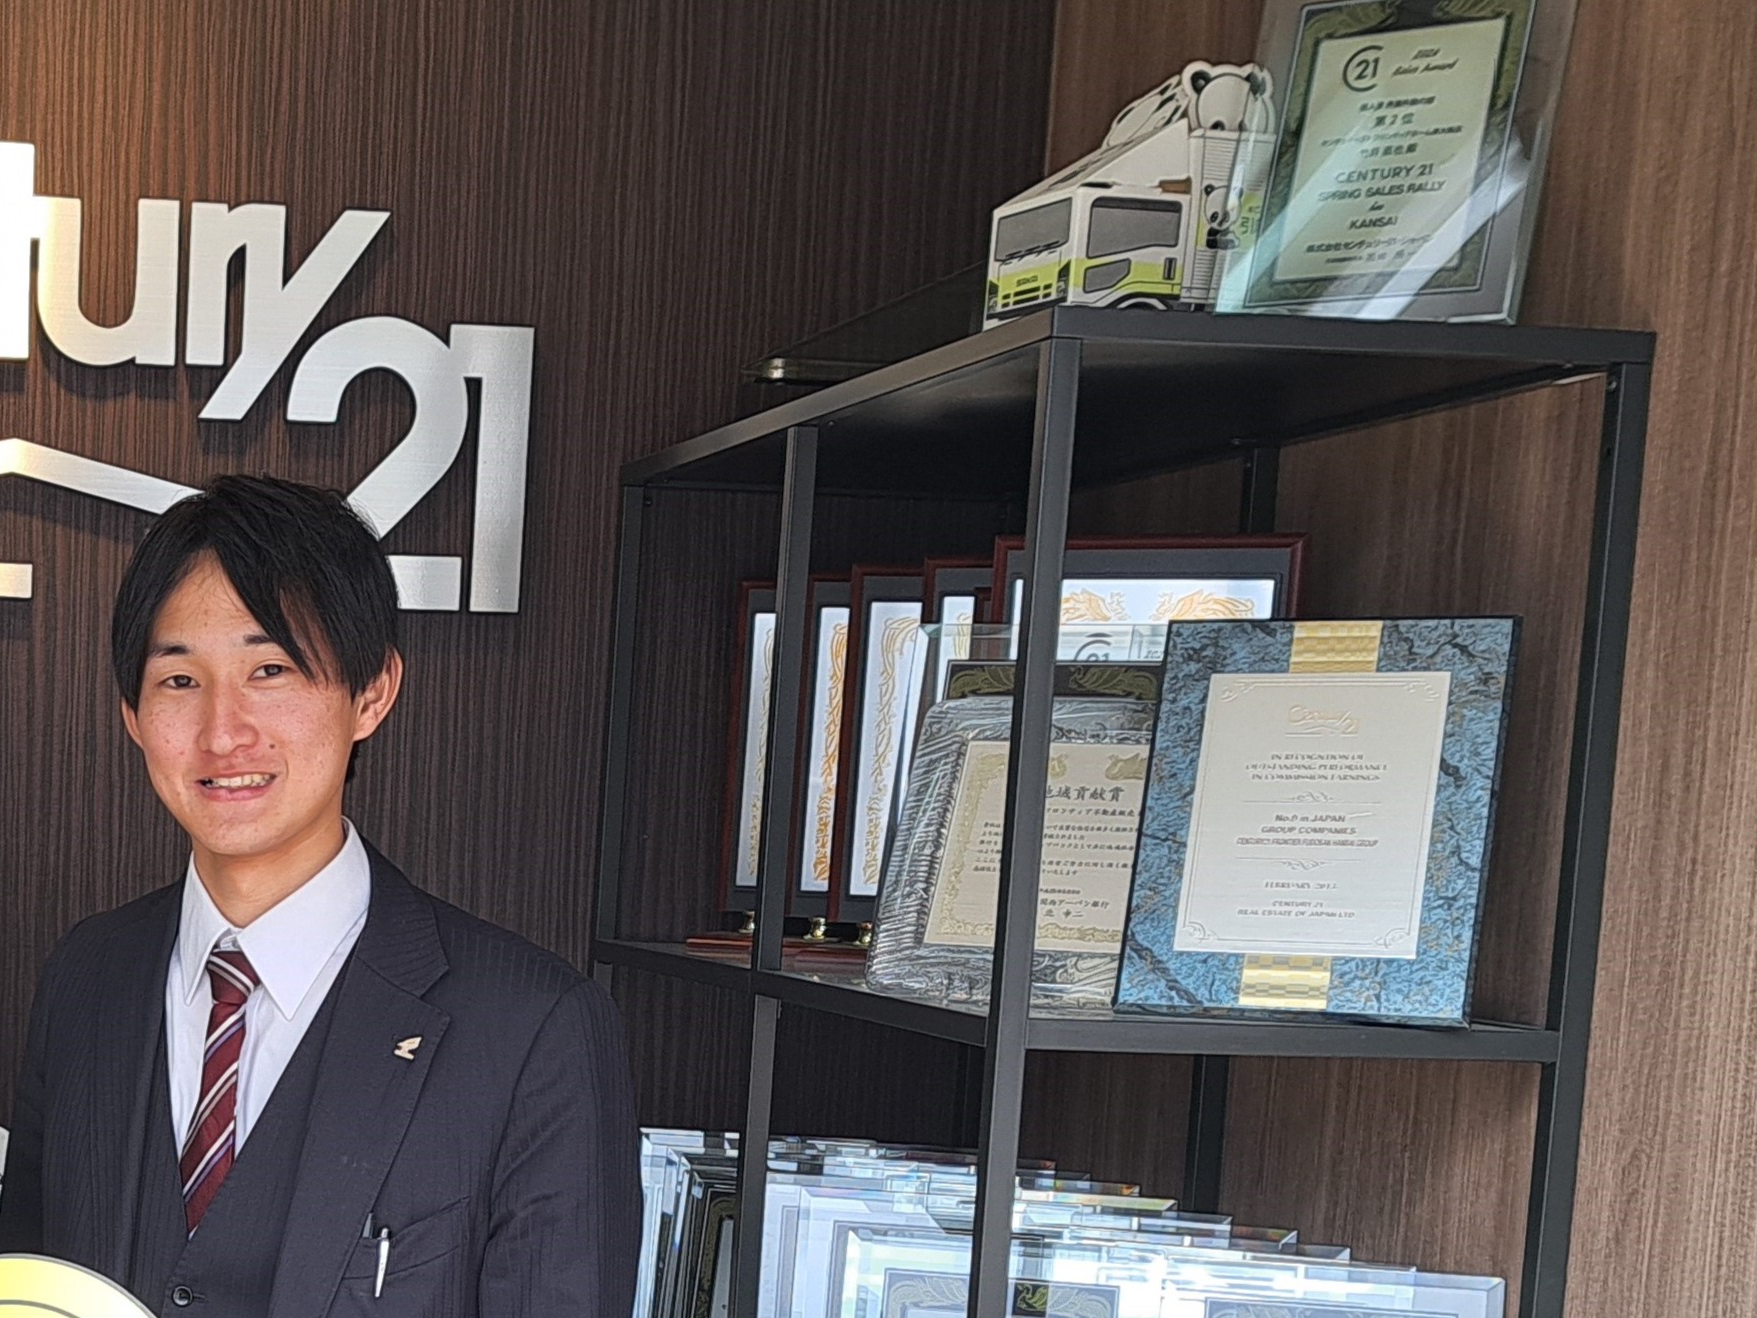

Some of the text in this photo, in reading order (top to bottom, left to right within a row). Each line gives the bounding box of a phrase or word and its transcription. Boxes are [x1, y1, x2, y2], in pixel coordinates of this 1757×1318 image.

[1335, 163, 1434, 184] CENTURY 21
[1349, 216, 1398, 230] KANSAI
[286, 316, 535, 613] 21
